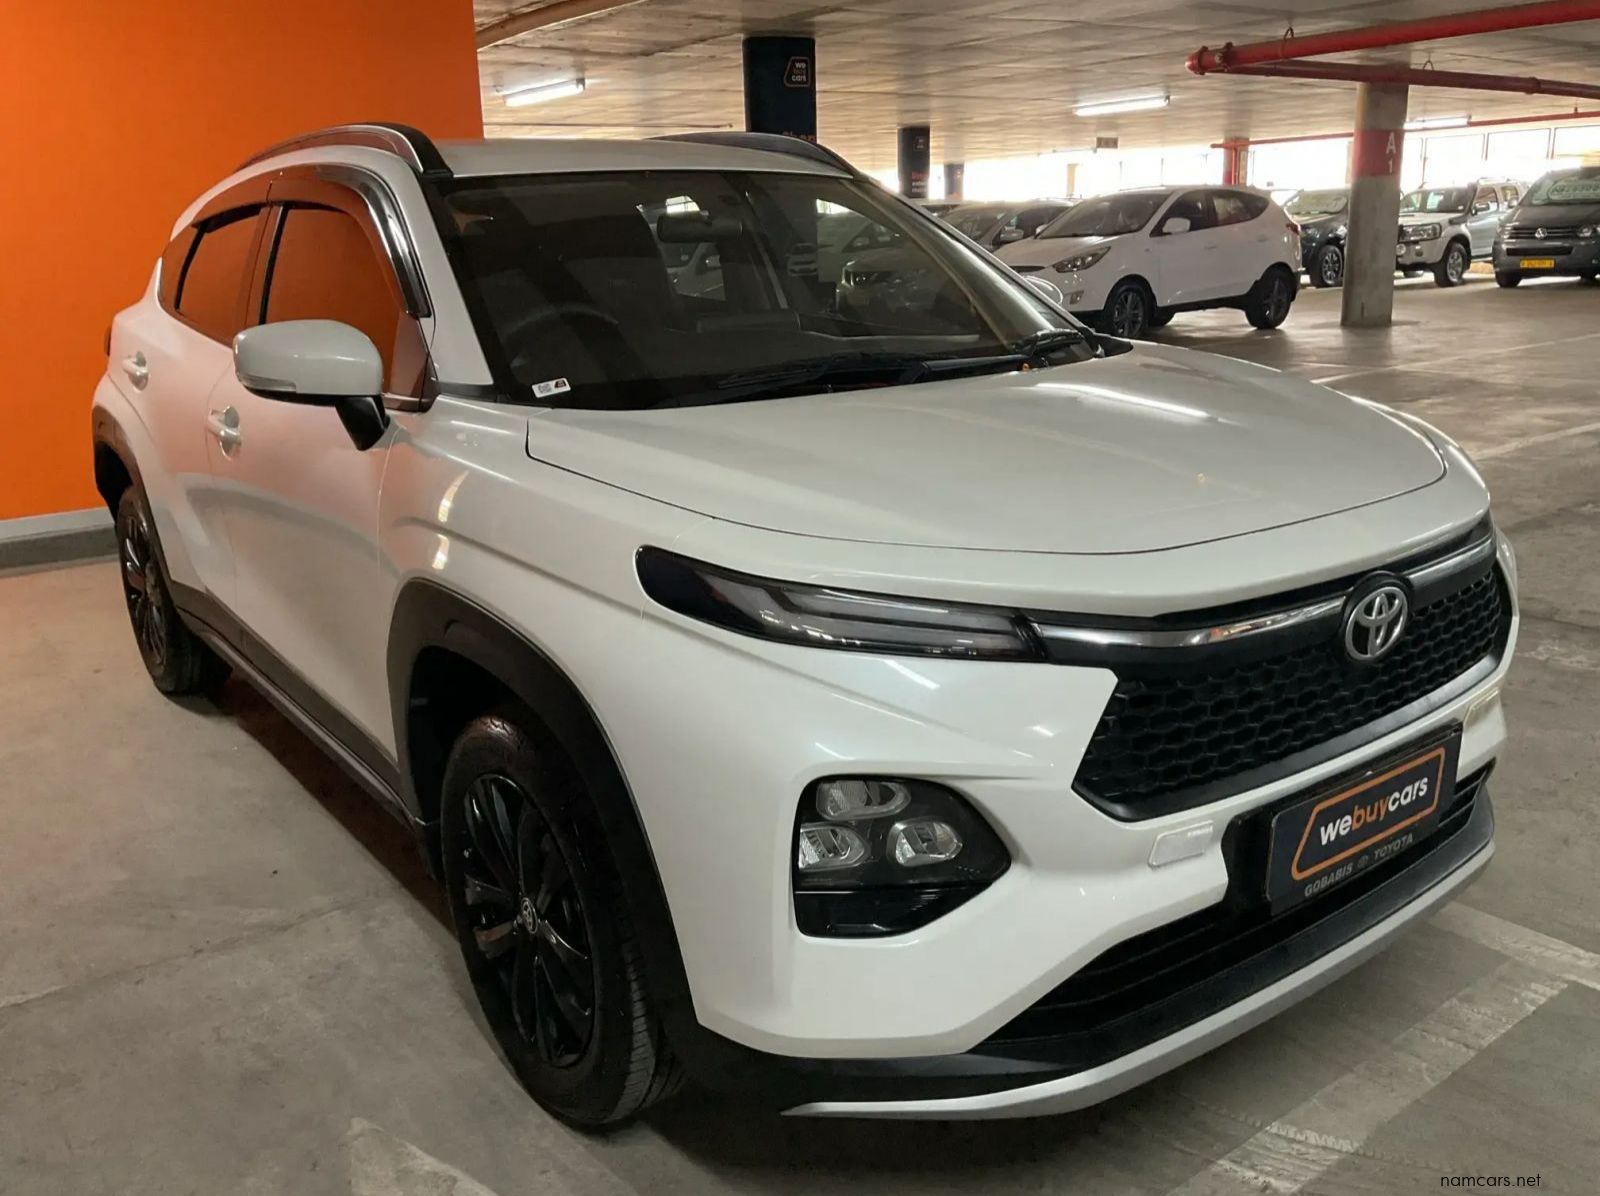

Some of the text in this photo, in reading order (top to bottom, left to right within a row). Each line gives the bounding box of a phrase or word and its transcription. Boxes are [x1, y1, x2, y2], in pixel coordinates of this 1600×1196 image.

[1385, 131, 1397, 155] A
[1320, 777, 1428, 846] webuycars
[1304, 832, 1413, 897] GOBABIS TOYOTA
